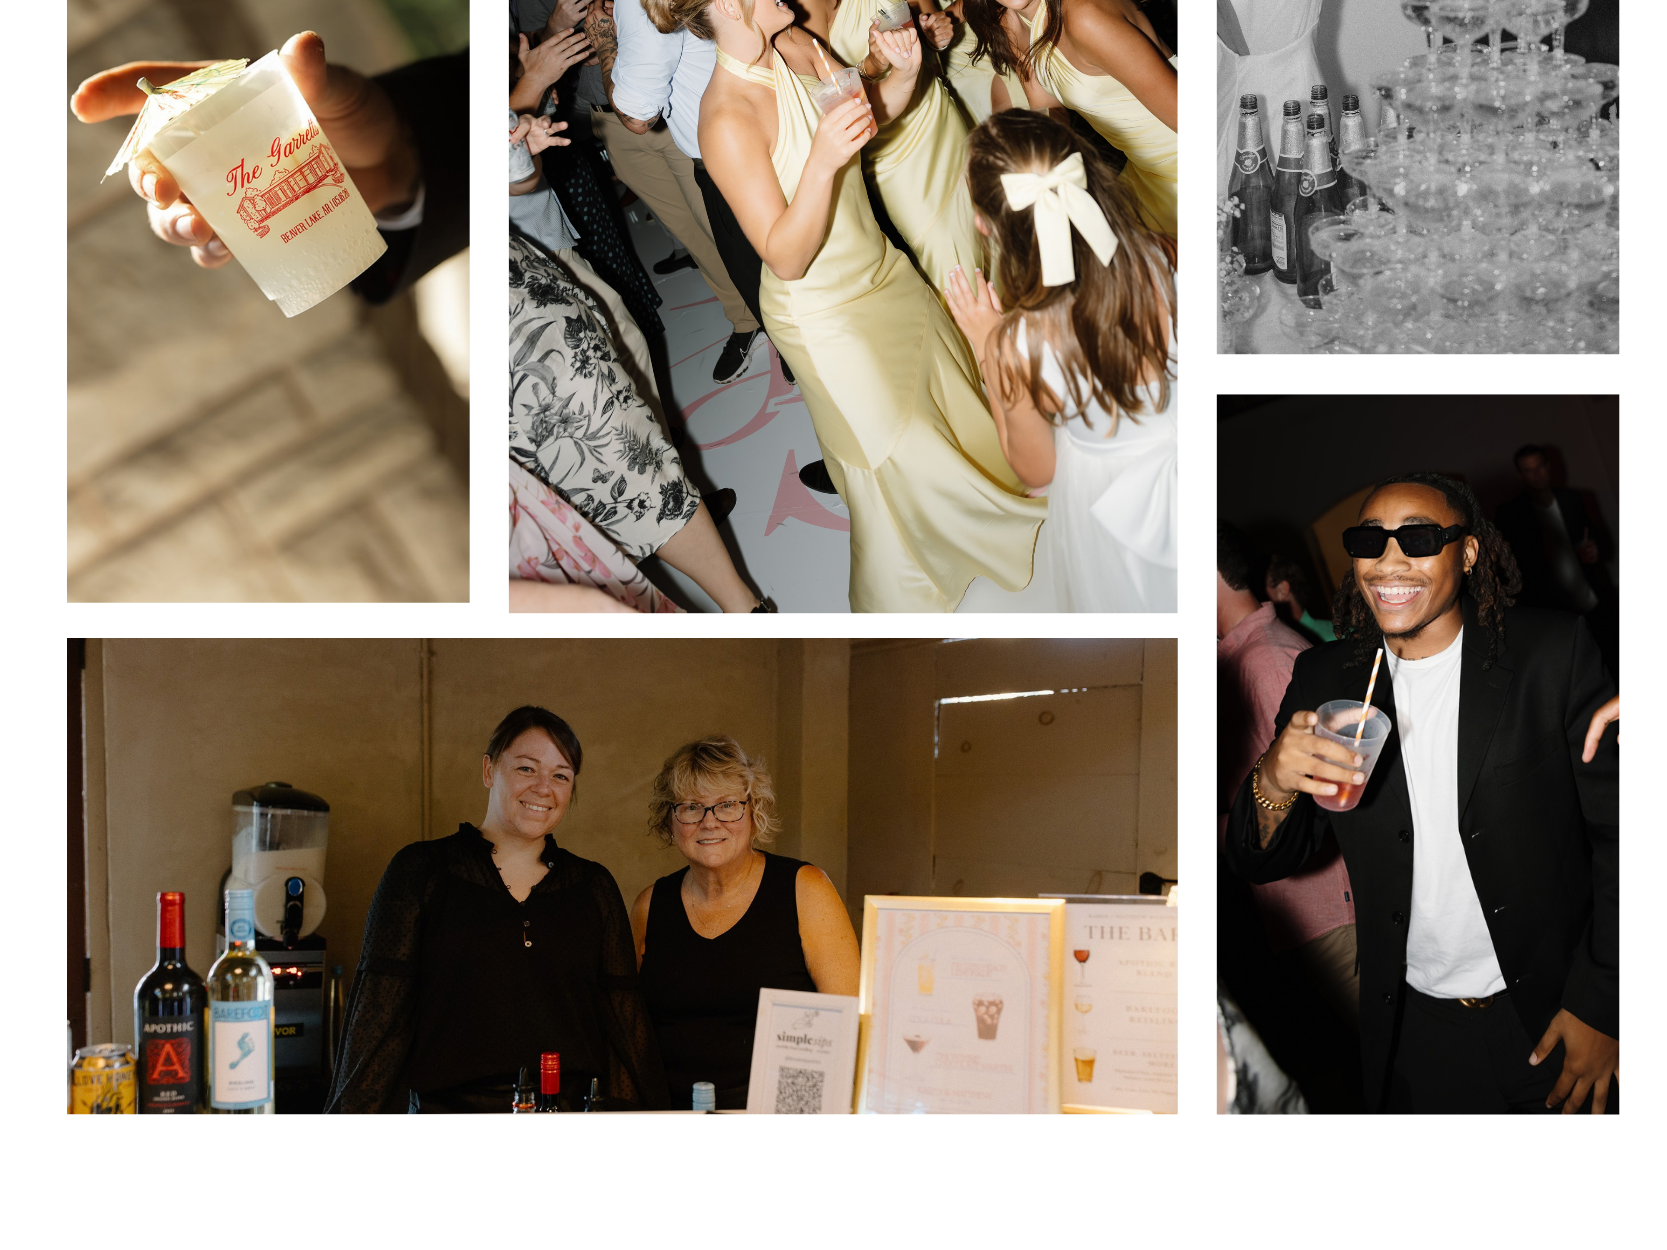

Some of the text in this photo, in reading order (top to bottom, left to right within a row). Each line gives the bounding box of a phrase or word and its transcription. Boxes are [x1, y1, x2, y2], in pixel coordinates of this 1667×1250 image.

[226, 158, 263, 196] The
[280, 222, 308, 244] BEAVER
[321, 203, 334, 216] AR
[1084, 924, 1131, 941] THE
[213, 1004, 271, 1020] BAREFOOT
[143, 1020, 195, 1034] APOTHIC
[150, 1042, 187, 1079] A
